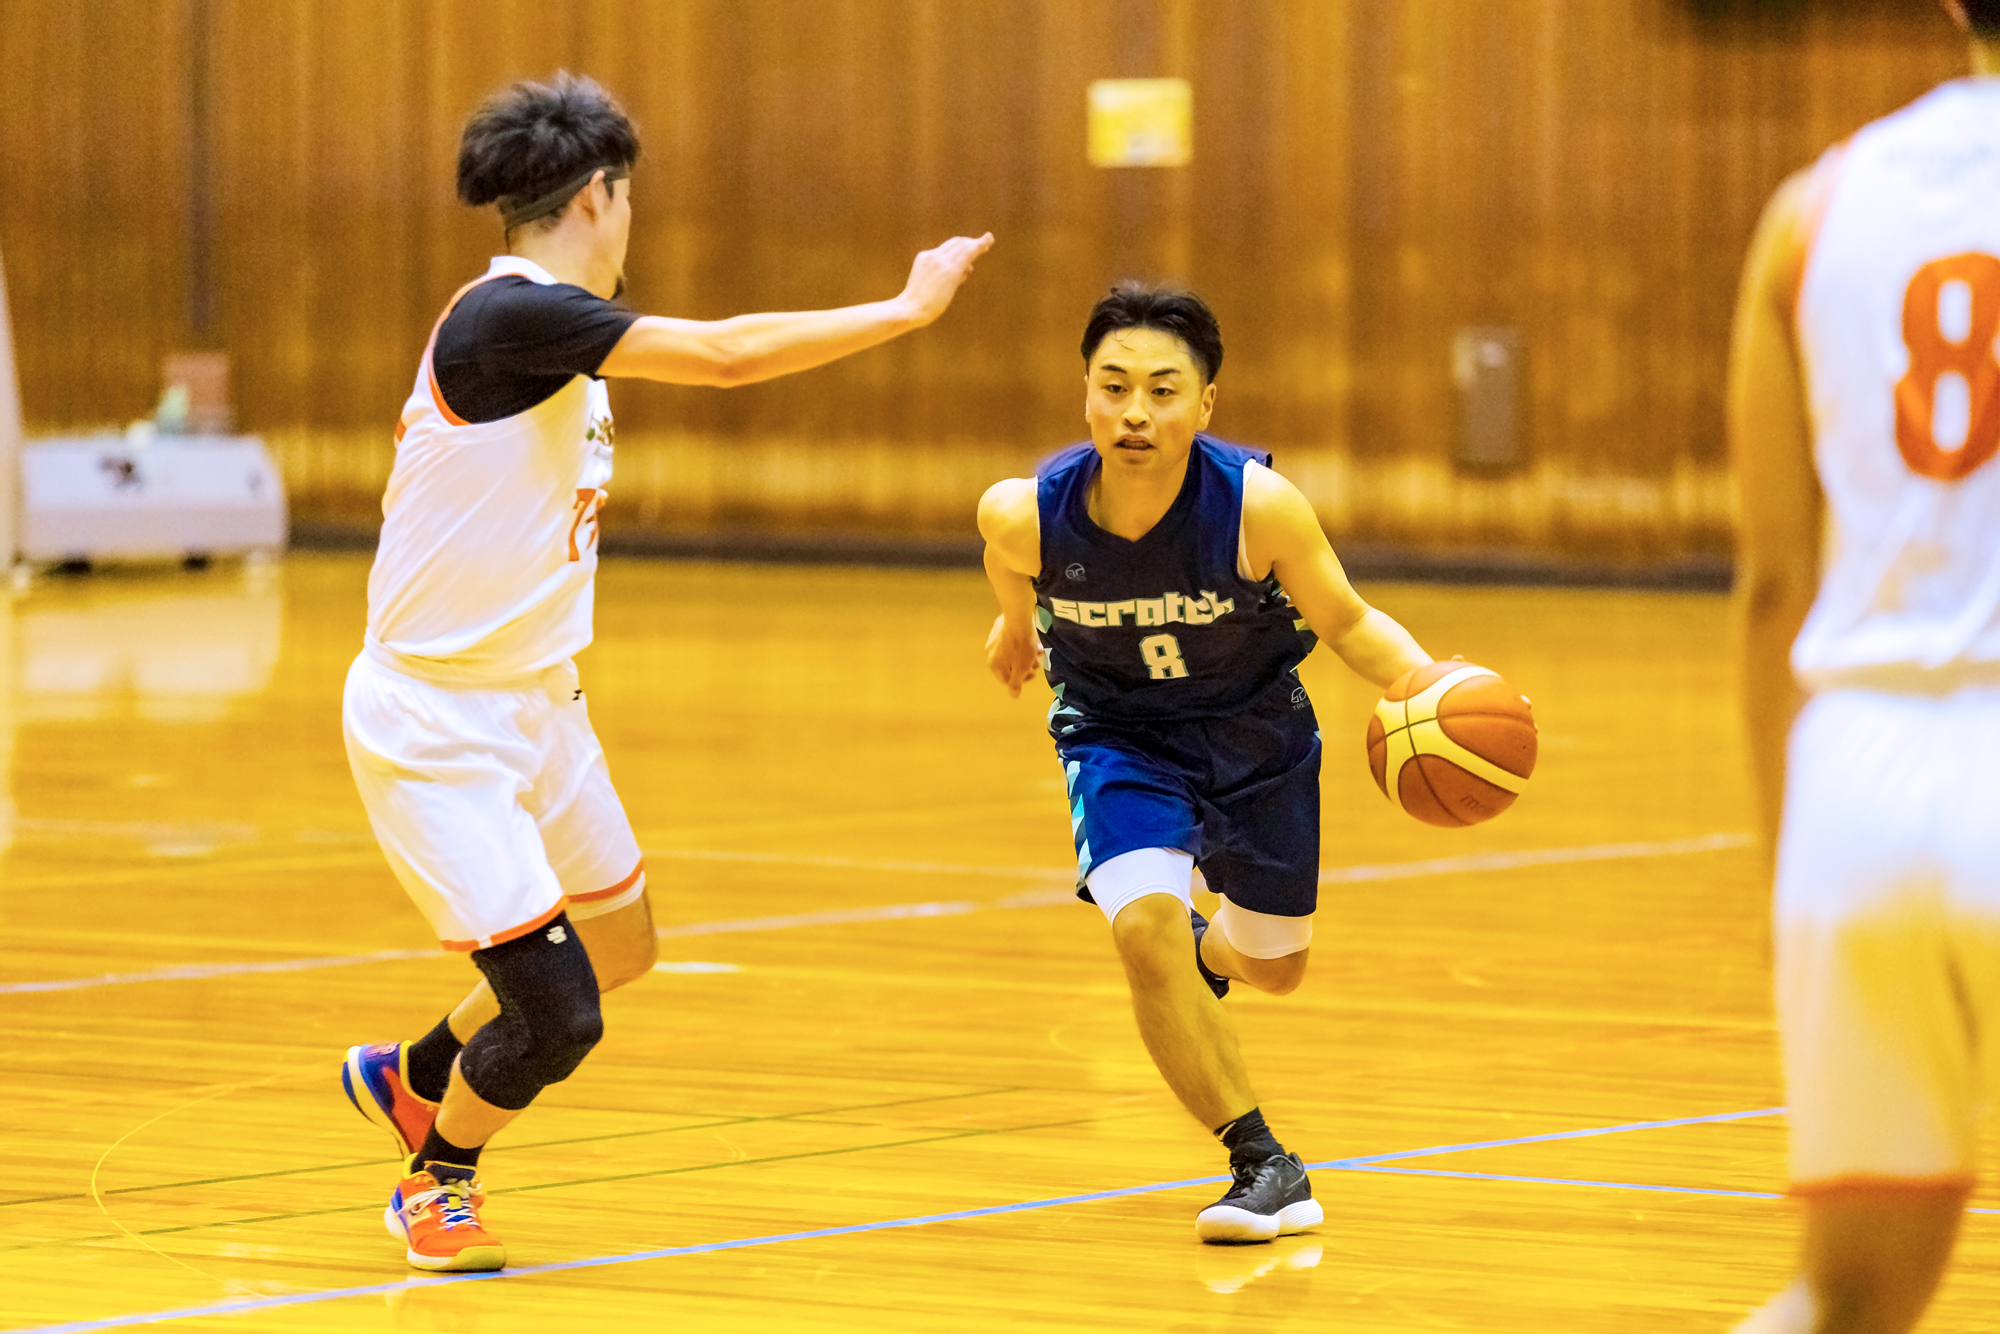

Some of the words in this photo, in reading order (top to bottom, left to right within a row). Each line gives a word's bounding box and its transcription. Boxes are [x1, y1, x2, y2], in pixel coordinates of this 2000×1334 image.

[1895, 251, 2000, 481] 8
[1049, 590, 1235, 628] scratch
[1138, 633, 1190, 680] 8
